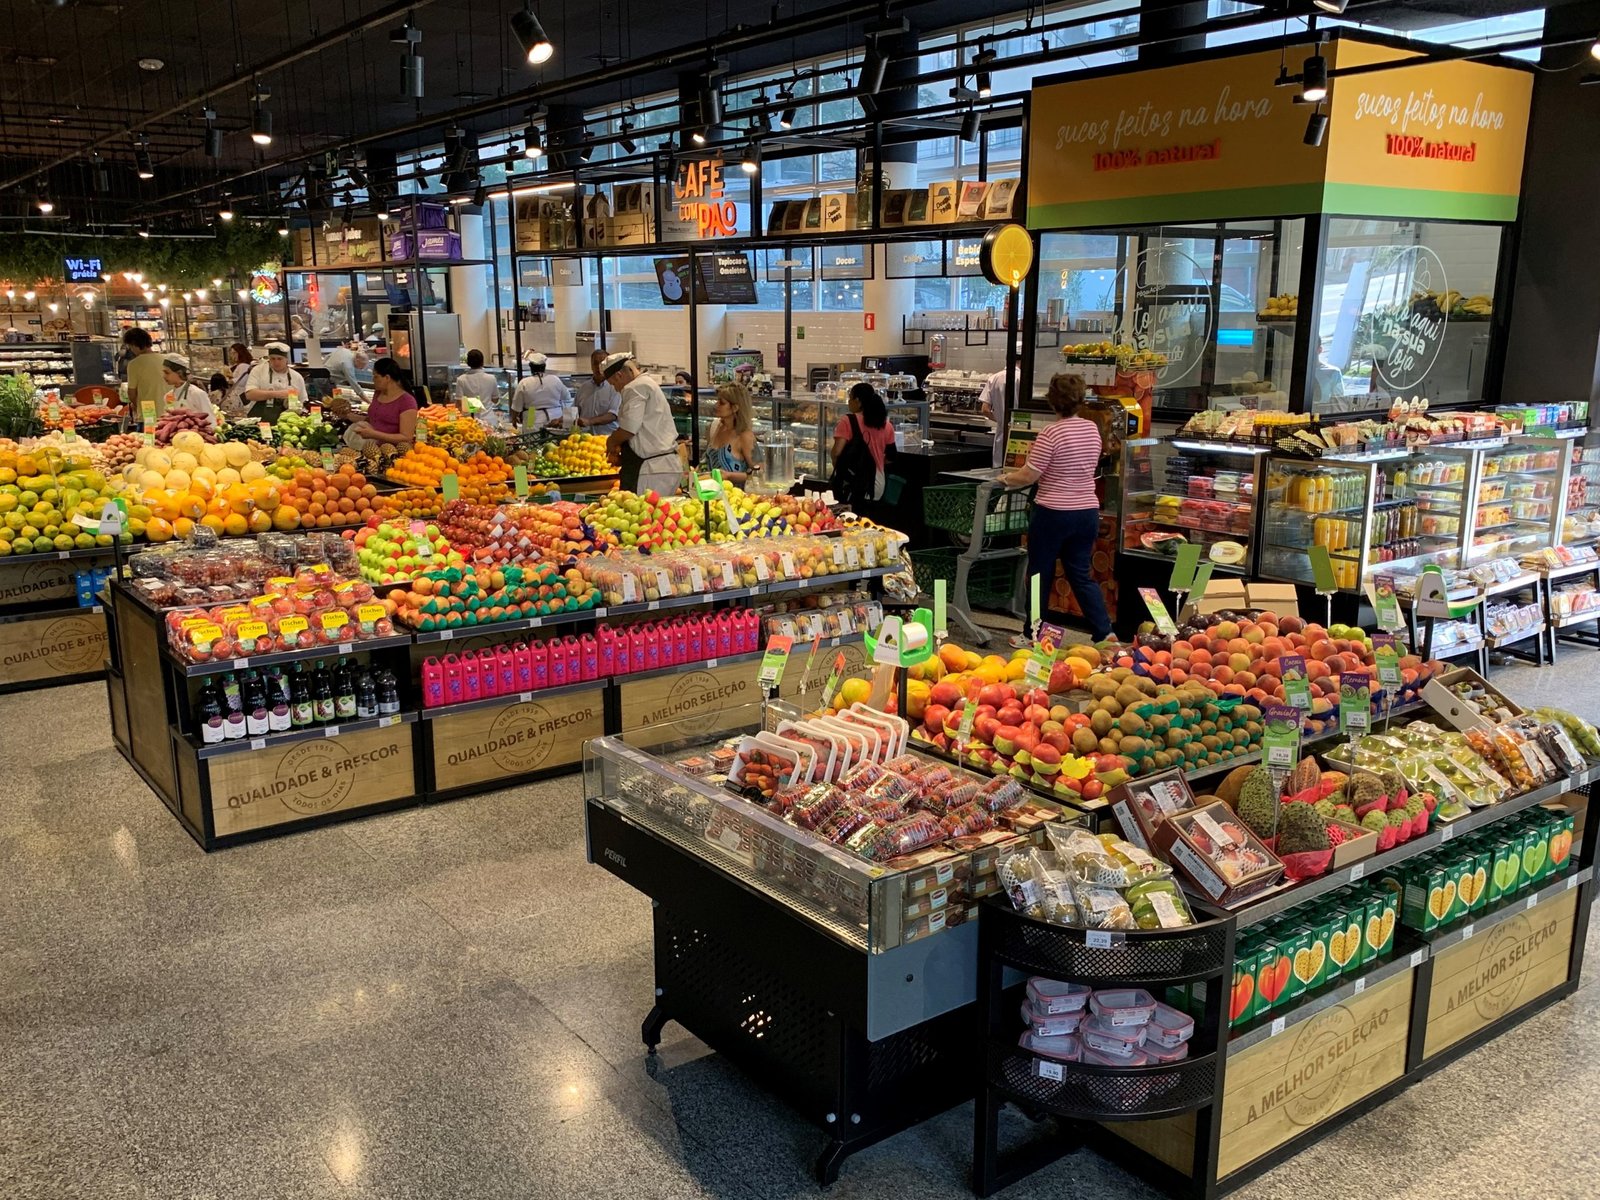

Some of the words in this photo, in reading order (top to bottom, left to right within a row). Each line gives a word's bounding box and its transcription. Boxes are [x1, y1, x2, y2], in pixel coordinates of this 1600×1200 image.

[1056, 119, 1109, 150] sucos
[1113, 101, 1173, 149] feitos
[1178, 107, 1208, 128] na
[1213, 85, 1273, 124] hora
[1355, 92, 1402, 125] sucos
[1401, 88, 1448, 133] feitos
[1449, 107, 1471, 126] na
[1471, 92, 1504, 130] hora
[1092, 149, 1141, 172] 100%
[1145, 138, 1222, 166] natural
[1386, 133, 1426, 158] 100%
[1426, 142, 1477, 162] natural
[422, 237, 445, 249] James
[958, 244, 981, 255] Bebid
[66, 259, 101, 270] Wi-Fi
[72, 270, 97, 279] grátis
[835, 257, 856, 266] Doces
[955, 257, 980, 267] Espec
[1382, 318, 1402, 339] na
[1402, 329, 1426, 355] sua
[1410, 312, 1442, 345] aqui
[1387, 334, 1415, 378] loja
[281, 619, 304, 627] Fischer
[4, 640, 75, 666] QUALIDADE
[77, 637, 86, 648] &
[642, 715, 650, 726] A
[652, 697, 698, 722] MELHOR
[700, 680, 746, 705] SELEÇÃO
[1268, 706, 1297, 717] Graviola
[498, 709, 520, 727] DESDE
[447, 731, 525, 766] QUALIDADE
[527, 728, 537, 739] &
[539, 708, 593, 735] FRESCOR
[288, 746, 311, 766] DESDE
[227, 769, 318, 810] QUALIDADE
[321, 766, 333, 779] &
[336, 743, 399, 775] FRESCOR
[292, 796, 319, 809] TODOS
[332, 780, 347, 801] DIAS
[1446, 996, 1455, 1013] A
[1457, 957, 1507, 1004] MELHOR
[1508, 919, 1557, 967] SELEÇÃO
[1247, 1104, 1257, 1123] A
[1261, 1056, 1324, 1114] MELHOR
[1327, 1008, 1389, 1065] SELEÇÃO
